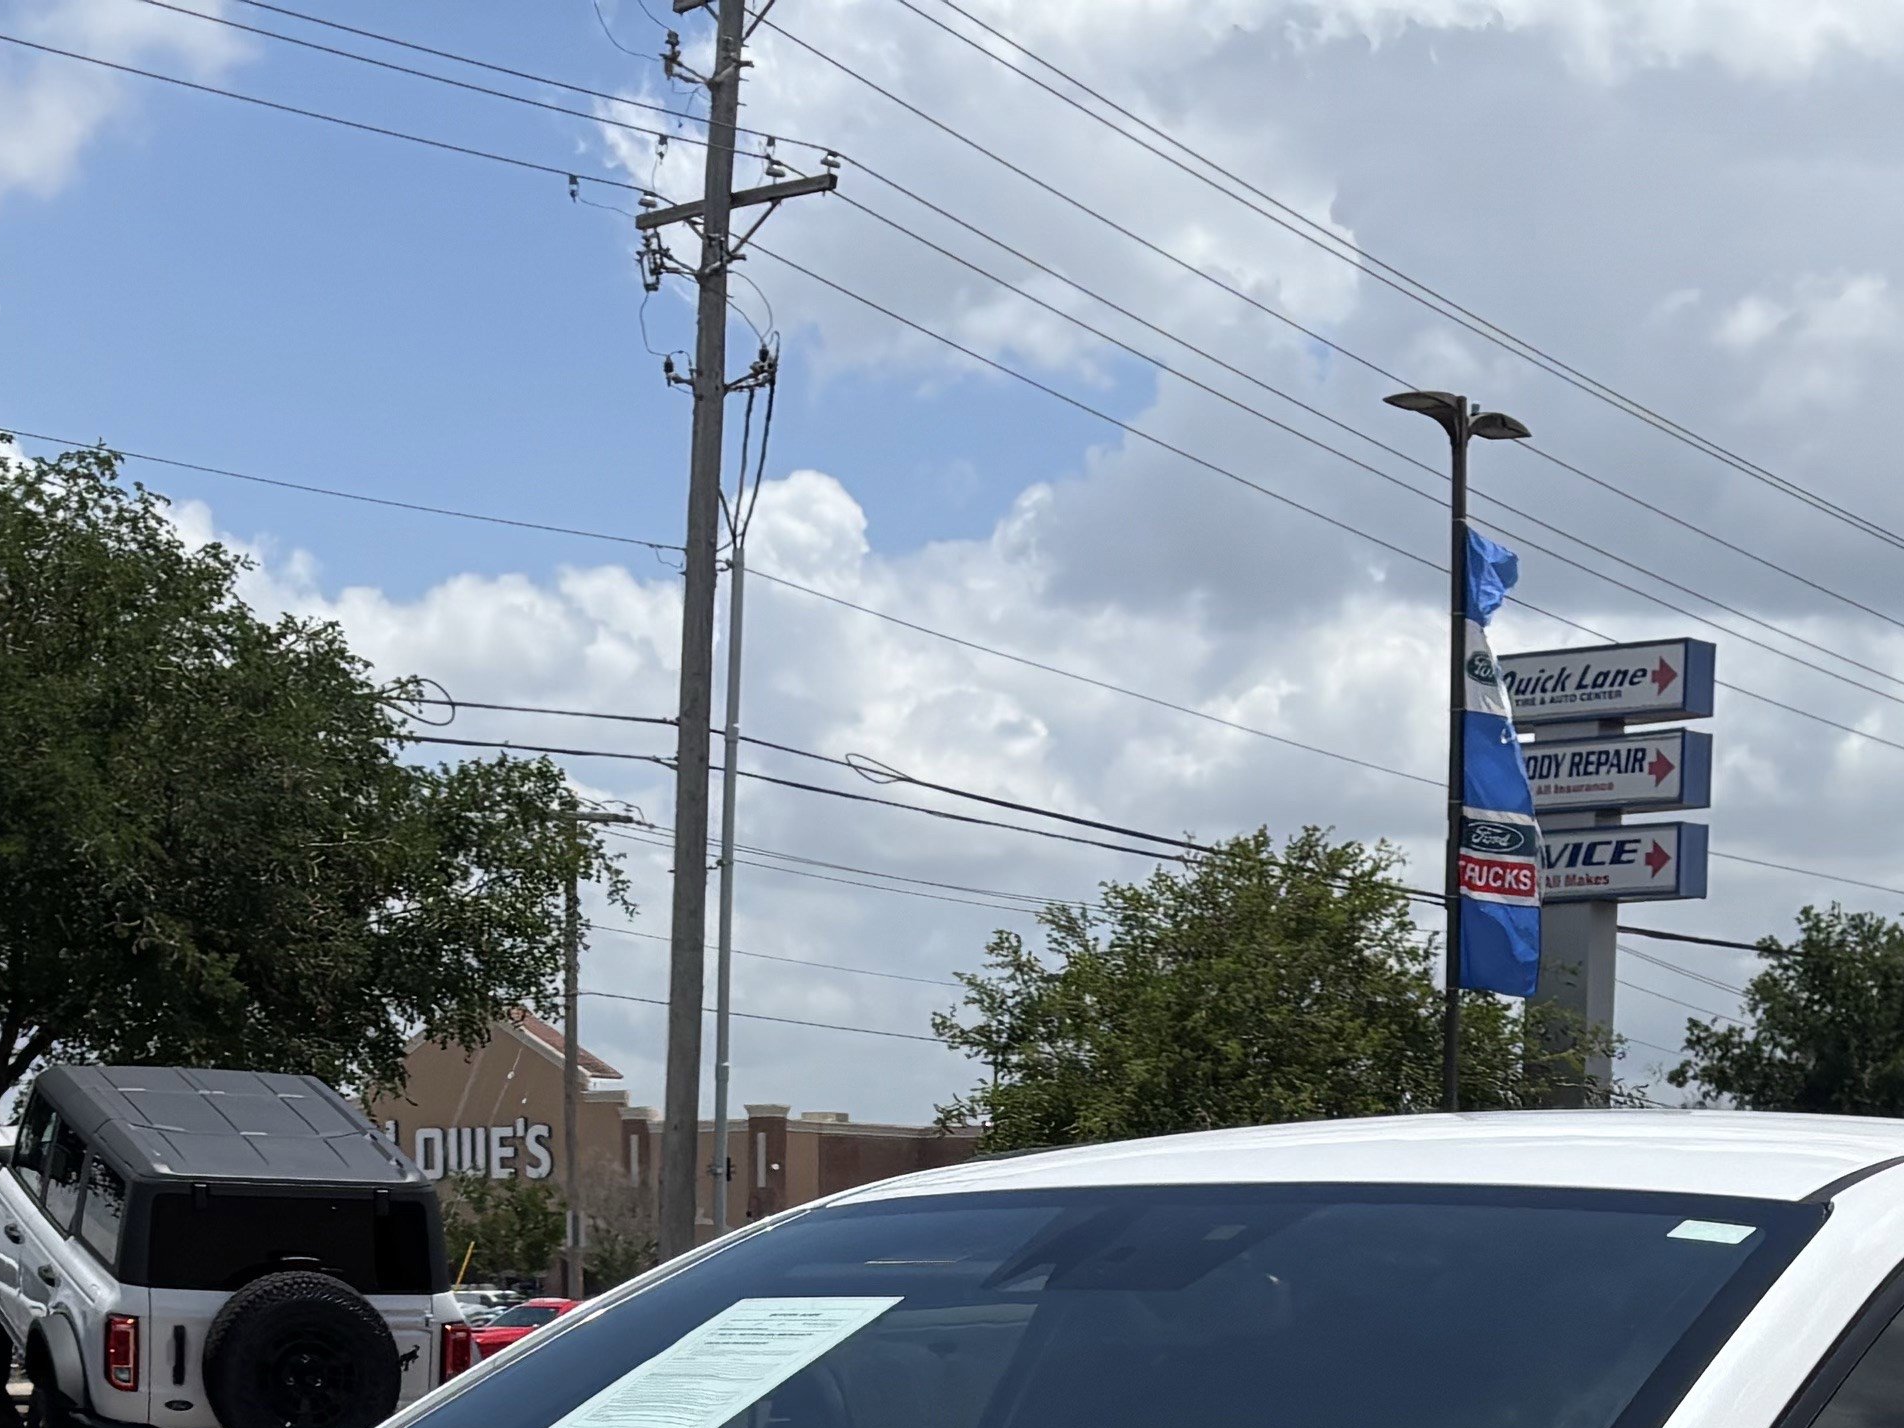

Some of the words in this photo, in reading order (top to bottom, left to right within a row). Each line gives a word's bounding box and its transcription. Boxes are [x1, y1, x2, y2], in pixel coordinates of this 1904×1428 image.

[1574, 664, 1647, 691] Lane
[1549, 693, 1578, 704] AUTO
[1579, 689, 1623, 703] CENTER
[1525, 752, 1567, 780] ODY
[1568, 747, 1647, 778] REPAIR
[1553, 781, 1615, 794] Insurance
[1470, 825, 1513, 848] Ford
[1544, 838, 1642, 869] VICE
[1459, 860, 1532, 891] RUCKS
[1564, 873, 1610, 888] Makes
